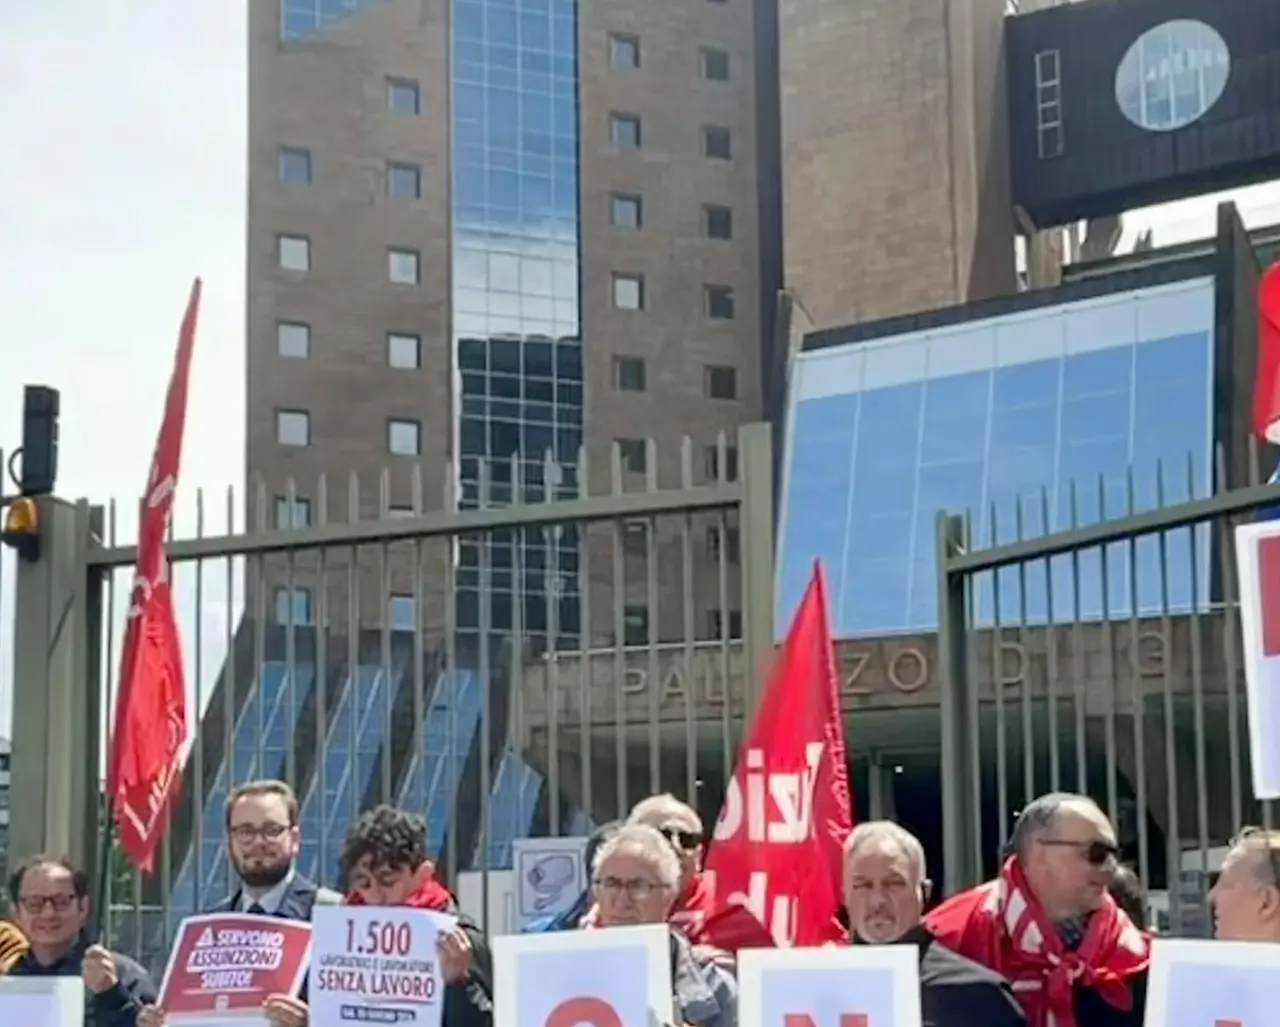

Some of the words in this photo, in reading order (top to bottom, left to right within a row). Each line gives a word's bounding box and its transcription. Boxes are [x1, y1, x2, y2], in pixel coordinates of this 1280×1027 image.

[346, 919, 411, 956] 1.500
[318, 969, 366, 993] SENZA
[371, 974, 436, 998] LAVORO
